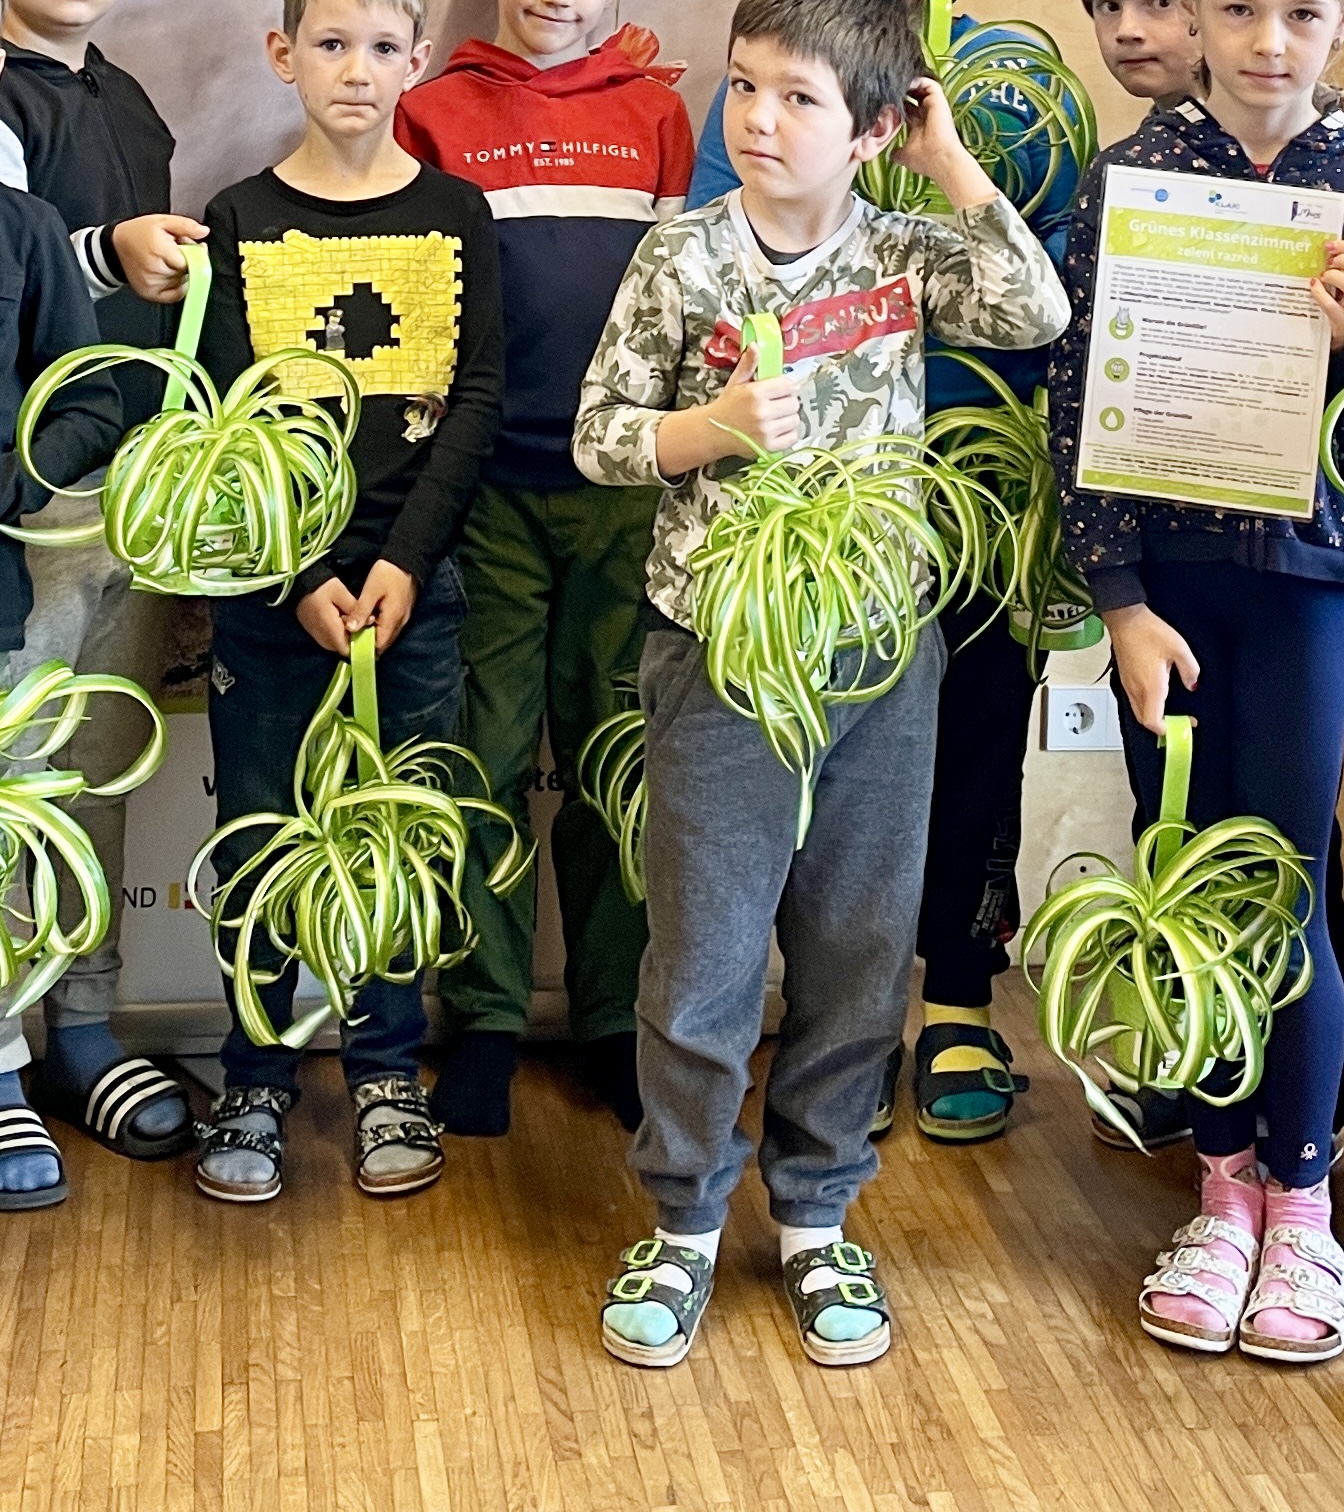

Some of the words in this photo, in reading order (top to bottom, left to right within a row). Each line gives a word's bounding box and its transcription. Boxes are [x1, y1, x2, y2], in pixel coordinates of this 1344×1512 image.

[463, 141, 536, 164] TOMMY
[562, 141, 641, 161] HILFIGER
[1128, 218, 1186, 238] Grünes
[1189, 224, 1313, 253] Klassenzimmer
[1217, 249, 1259, 265] razred
